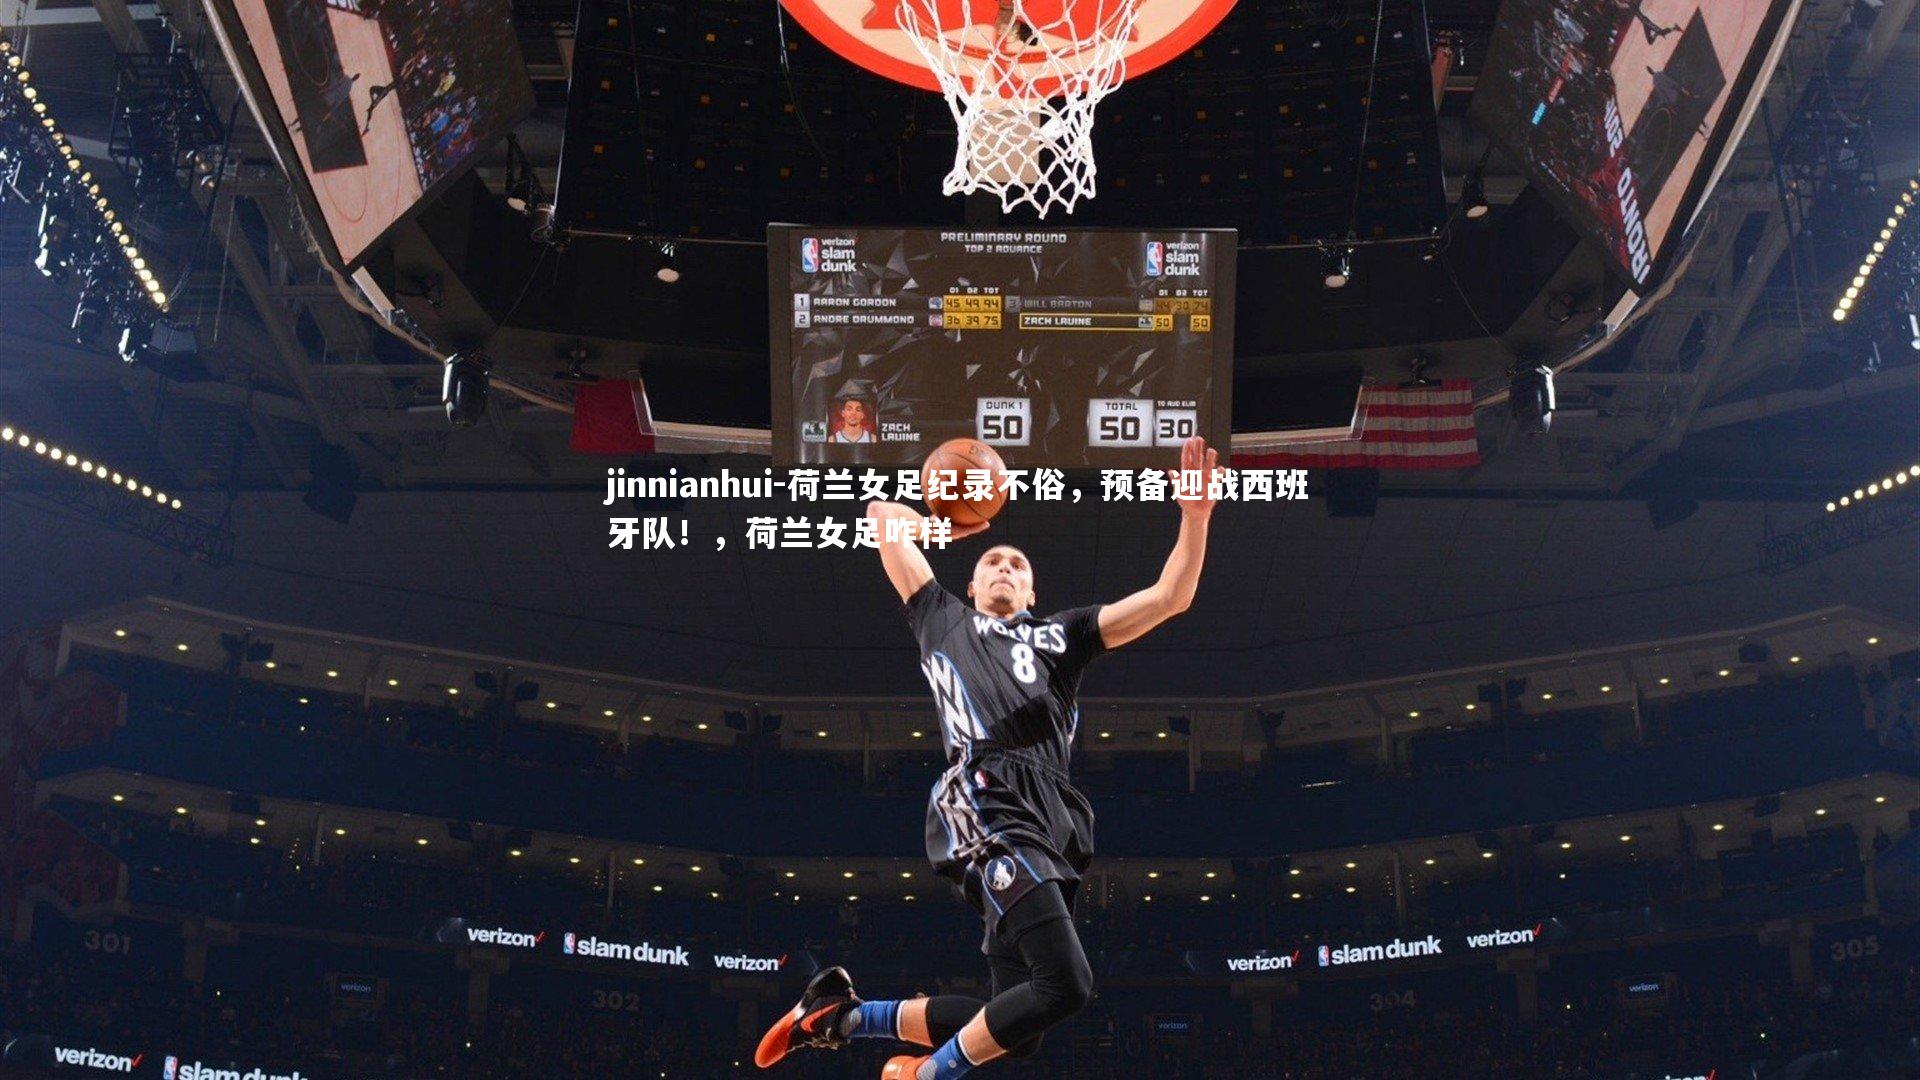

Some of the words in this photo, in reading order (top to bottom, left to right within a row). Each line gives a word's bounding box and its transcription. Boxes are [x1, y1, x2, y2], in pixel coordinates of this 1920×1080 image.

[821, 237, 855, 246] verizon
[941, 232, 1021, 243] PRELIMINARY
[1025, 233, 1067, 243] ROUND
[965, 244, 984, 252] TOP
[995, 245, 1043, 253] ADVANCE
[1165, 241, 1200, 250] verizon
[821, 246, 855, 259] slam
[1165, 250, 1199, 263] slam
[821, 259, 857, 272] dunk
[1165, 263, 1200, 276] dunk
[813, 298, 850, 307] AARON
[853, 298, 896, 307] GORDON
[946, 299, 960, 307] 45
[965, 299, 979, 307] 49
[983, 299, 999, 308] 94
[1024, 300, 1047, 308] WILL
[1050, 300, 1092, 309] BARTON
[799, 314, 806, 324] 2
[814, 315, 849, 324] ANDRE
[852, 315, 915, 324] DRUMMOND
[966, 316, 980, 325] 39
[984, 316, 999, 325] 75
[1024, 316, 1052, 325] ZACH
[1156, 318, 1170, 327] 50
[1193, 319, 1208, 327] 50
[986, 401, 1015, 410] DUNK
[1105, 402, 1138, 411] TOTAL
[881, 423, 911, 432] ZACH
[983, 415, 1023, 440] 50
[1100, 416, 1140, 441] 50
[1160, 418, 1193, 438] 30
[1011, 643, 1037, 684] 8
[467, 927, 536, 948] verizon
[1468, 928, 1534, 948] verizon
[577, 936, 631, 960] slam
[632, 942, 690, 967] dunk
[1331, 944, 1384, 966] slam
[1386, 935, 1442, 961] dunk
[714, 954, 779, 971] verizon
[1227, 954, 1292, 971] verizon
[340, 981, 371, 993] verizon
[1629, 982, 1659, 993] verizon
[54, 1046, 132, 1072] verizon
